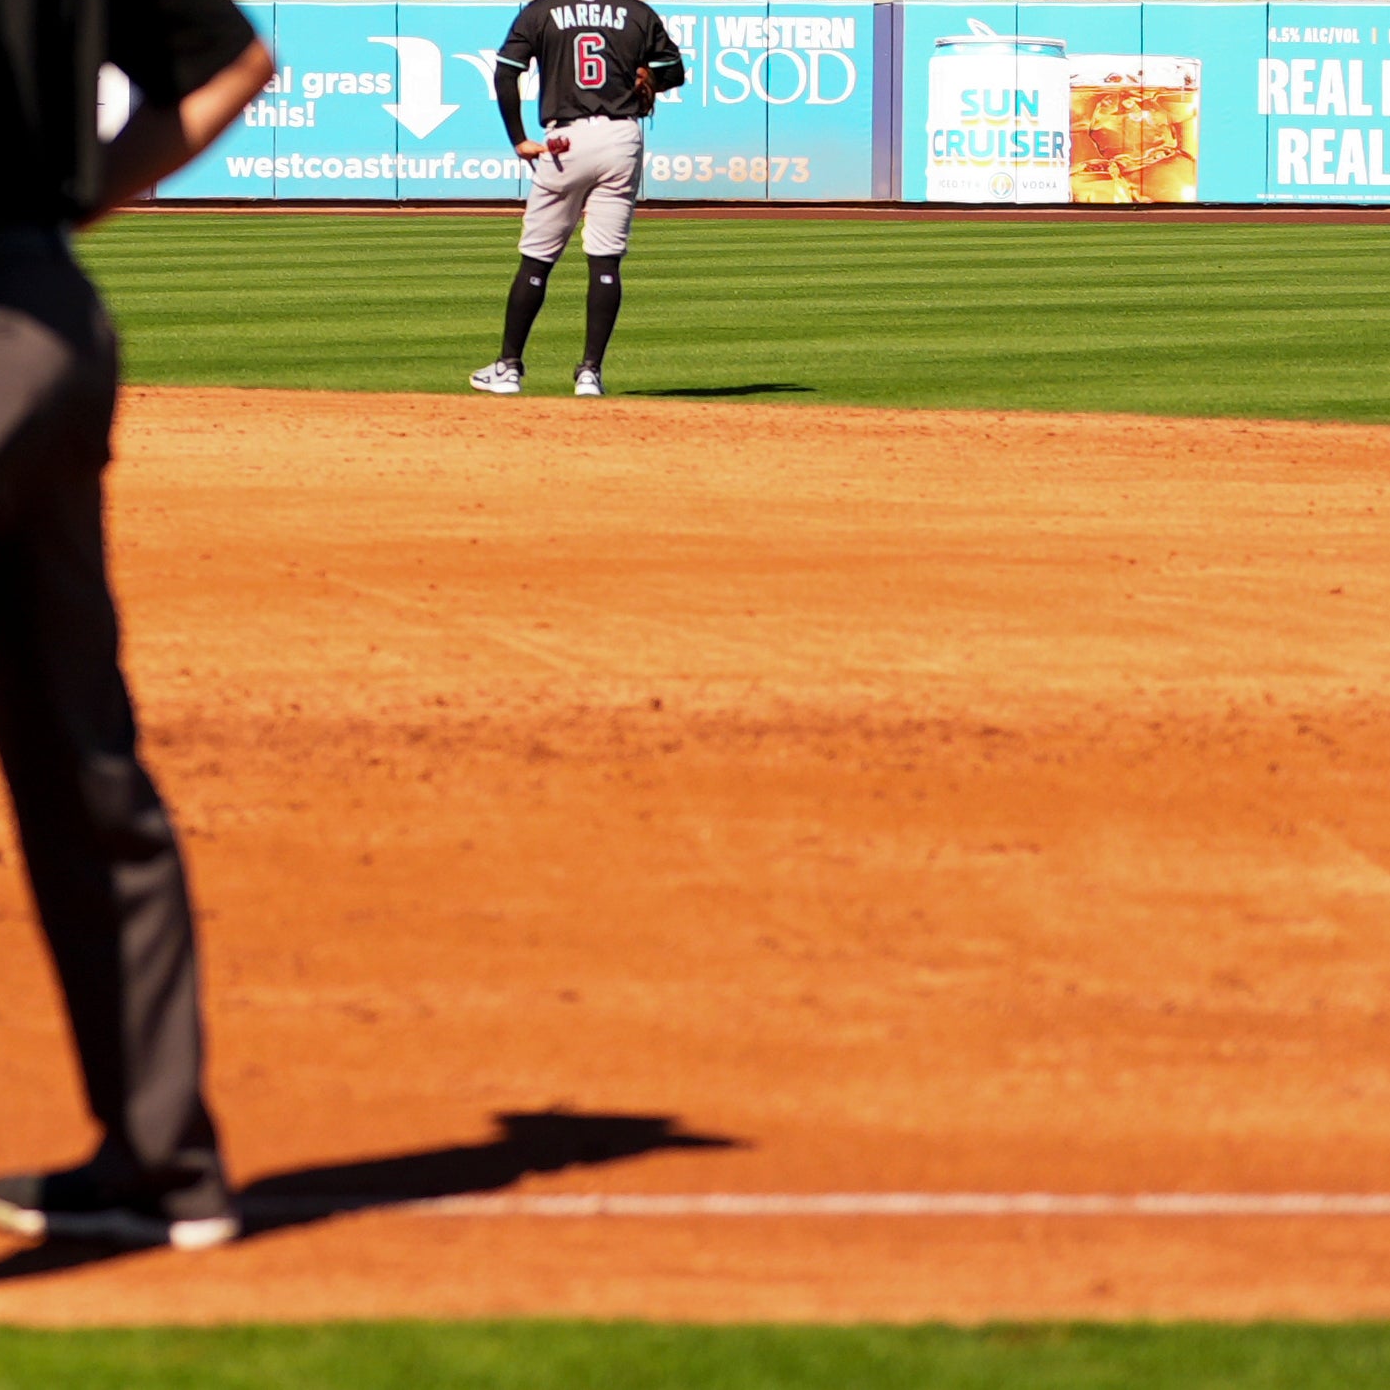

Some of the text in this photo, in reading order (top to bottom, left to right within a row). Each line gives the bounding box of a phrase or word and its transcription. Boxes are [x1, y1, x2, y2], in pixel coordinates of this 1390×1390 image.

[550, 3, 628, 30] VARGAS
[714, 16, 856, 48] WESTERN
[1304, 27, 1360, 44] ALC/VOL
[574, 32, 607, 89] 6
[302, 72, 392, 99] grass
[713, 48, 857, 105] SOD
[1258, 58, 1373, 117] REAL
[243, 99, 315, 128] this!
[961, 89, 1040, 119] SUN
[932, 128, 1066, 159] CRUISER
[1277, 128, 1390, 186] REAL
[226, 151, 533, 179] westcoastturf.com
[1022, 180, 1057, 190] VODKA
